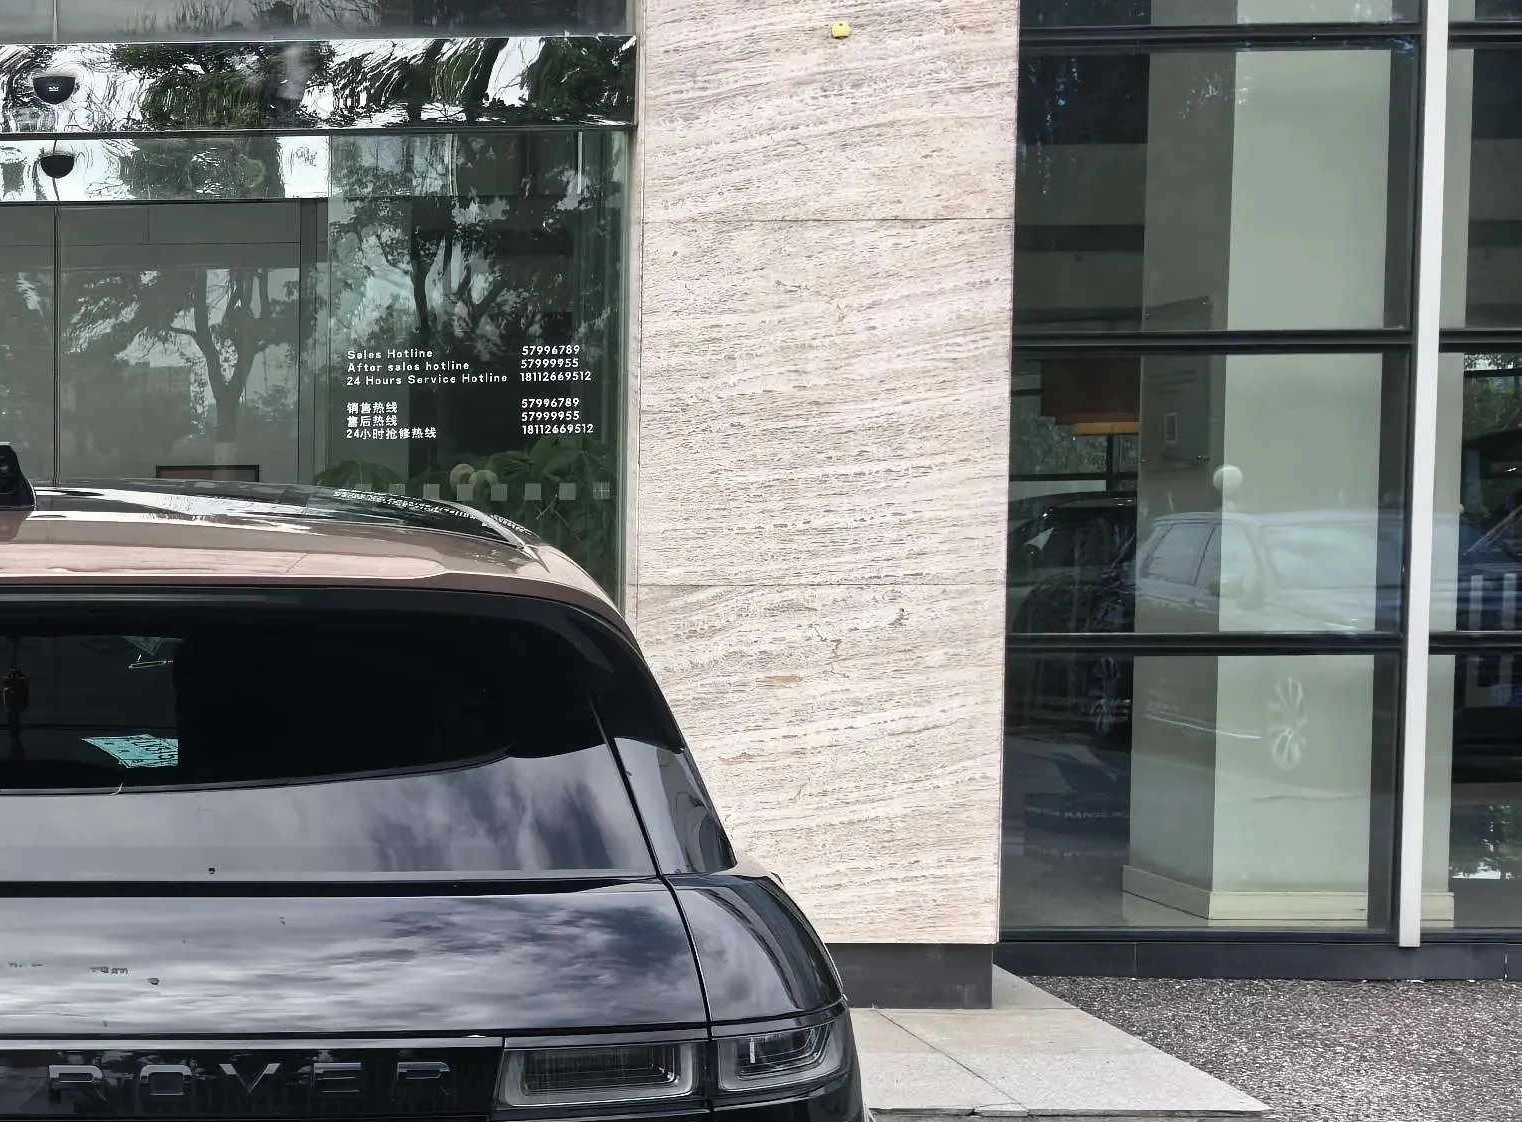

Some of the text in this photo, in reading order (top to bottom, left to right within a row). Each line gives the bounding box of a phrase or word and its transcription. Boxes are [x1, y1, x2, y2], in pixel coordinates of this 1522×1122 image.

[347, 348, 433, 360] Sales Hotline
[522, 345, 579, 355] 57996789
[348, 361, 469, 372] After sales hotline
[520, 359, 579, 368] 57999955
[347, 374, 507, 386] 24 Hours Service Hotline
[519, 372, 591, 382] 18112669512
[346, 402, 398, 414] 销售热线
[521, 398, 579, 408] 57996789
[346, 416, 398, 427] 售后热线
[521, 411, 579, 421] 57999955
[346, 427, 436, 440] 24小时抢修热线
[522, 424, 593, 434] 18112669512
[48, 1061, 452, 1104] ROVER
